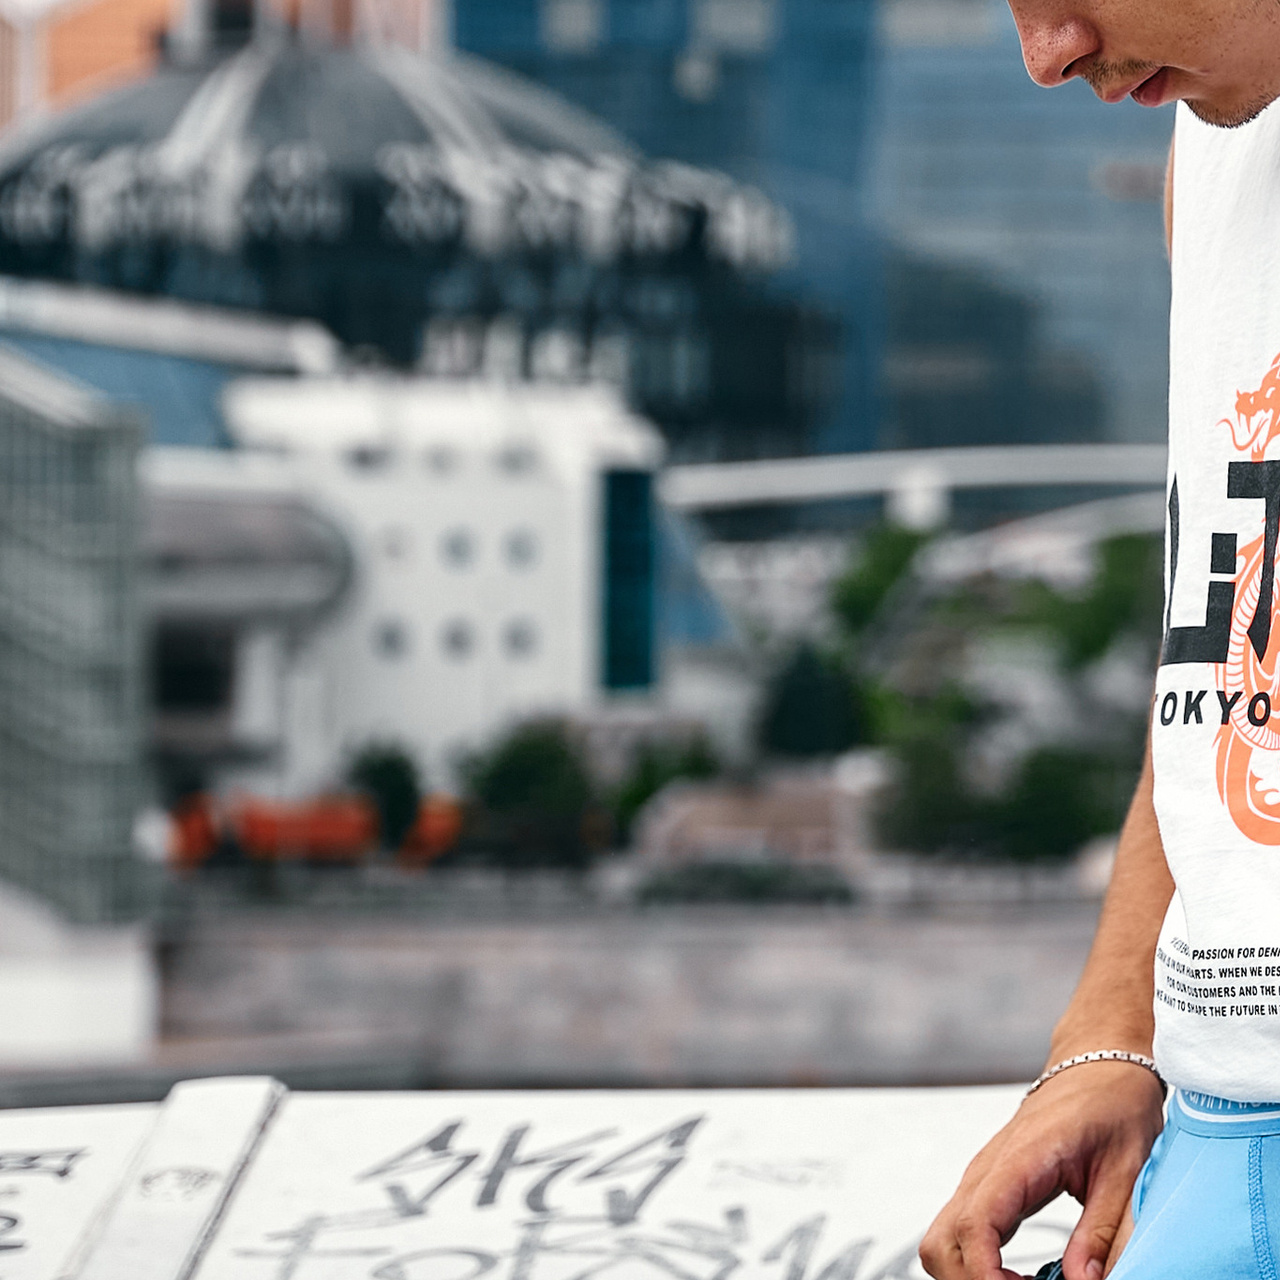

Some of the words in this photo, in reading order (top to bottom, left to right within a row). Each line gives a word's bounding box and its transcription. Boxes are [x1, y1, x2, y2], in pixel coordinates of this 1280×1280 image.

[1155, 690, 1271, 726] OKYO
[1192, 948, 1234, 960] PASSION
[1237, 948, 1255, 959] FOR
[1219, 967, 1247, 978] WHEN
[1250, 966, 1262, 977] WE
[1239, 986, 1258, 997] AND
[1260, 985, 1276, 996] THE
[1177, 1000, 1186, 1011] TO
[1209, 1006, 1227, 1017] THE
[1230, 1005, 1265, 1016] FUTURE
[1268, 1005, 1277, 1015] IN
